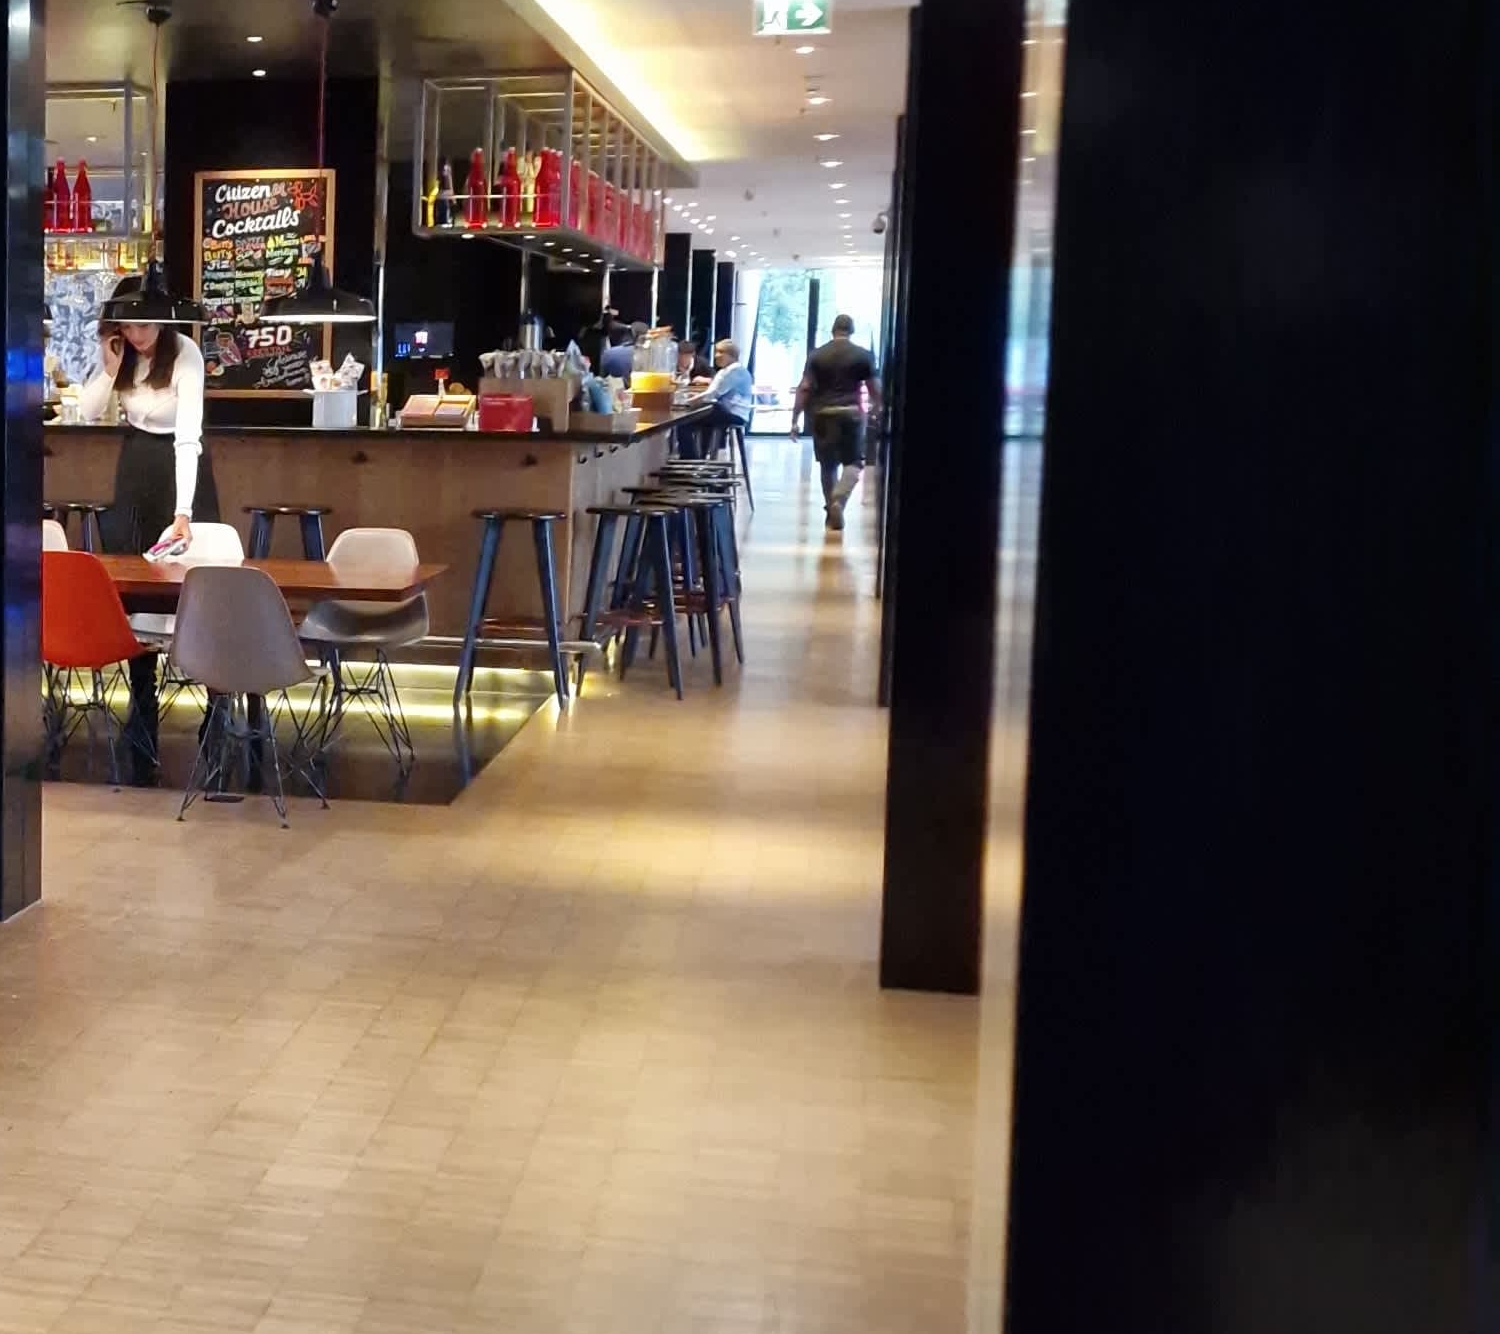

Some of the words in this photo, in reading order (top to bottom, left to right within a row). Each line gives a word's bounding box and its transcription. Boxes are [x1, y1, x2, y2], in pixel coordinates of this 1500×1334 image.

[221, 197, 281, 219] House
[211, 206, 301, 238] Cocktails
[245, 325, 293, 349] 750
